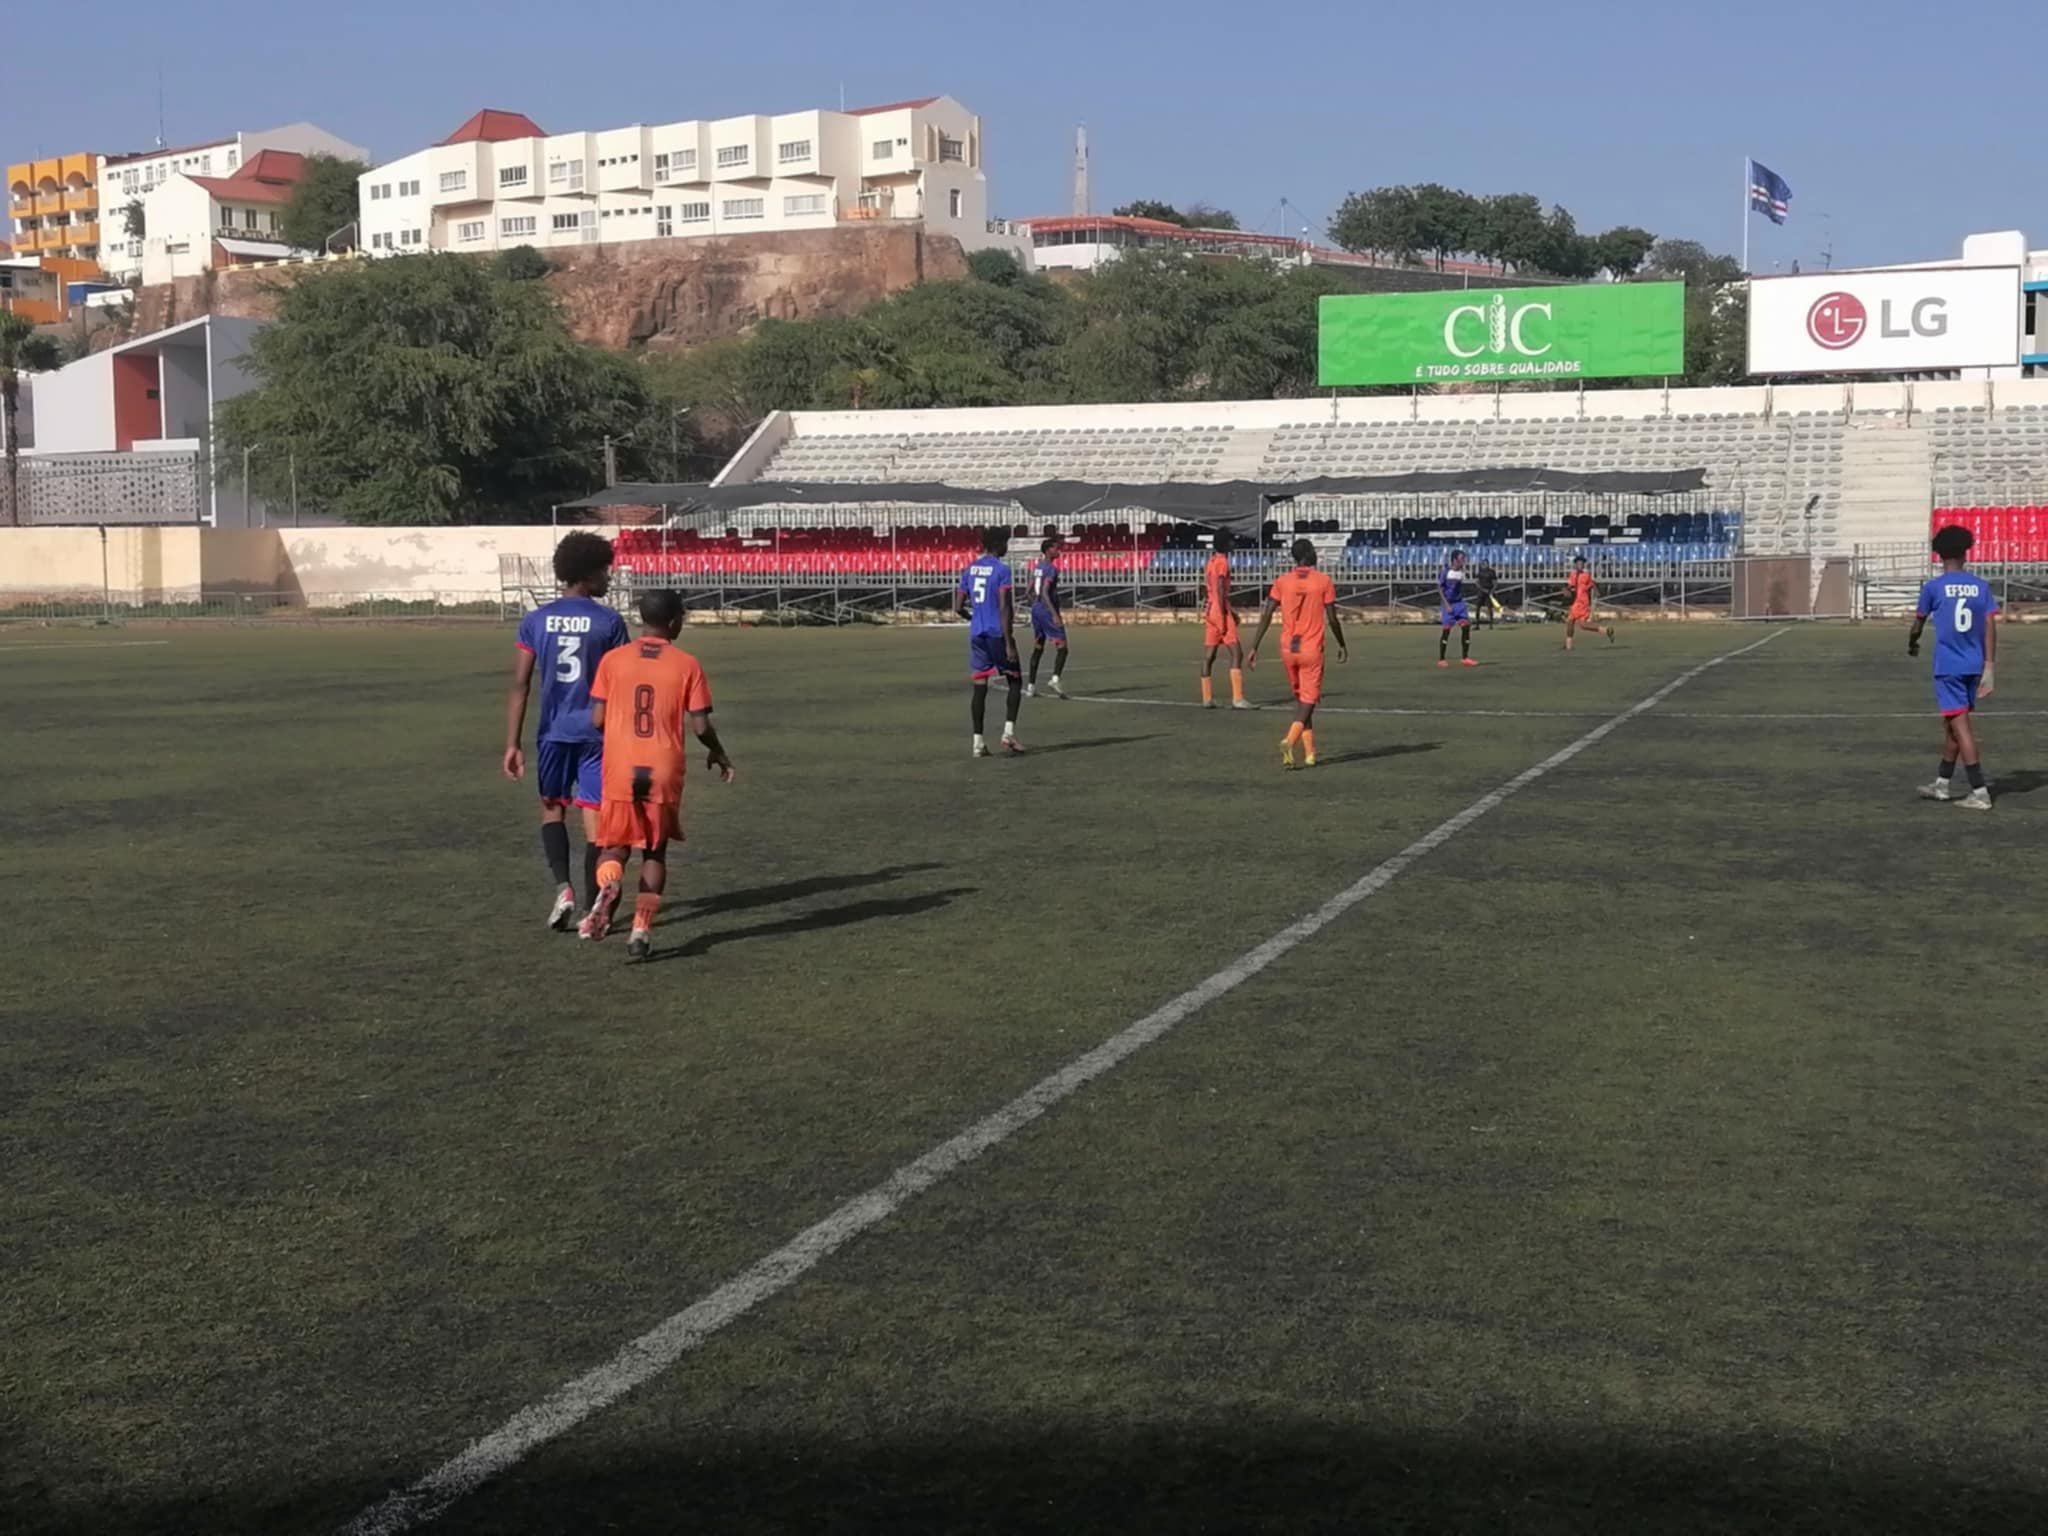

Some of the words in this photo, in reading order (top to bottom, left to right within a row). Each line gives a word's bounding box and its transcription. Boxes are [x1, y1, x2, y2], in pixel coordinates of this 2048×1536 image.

[1881, 297, 1948, 338] LG
[1427, 364, 1460, 378] TUDO
[1464, 363, 1505, 376] SOBRE
[1509, 361, 1582, 376] QUALIDADE
[973, 577, 987, 604] 5
[1944, 584, 1979, 598] EFSOD
[1295, 591, 1307, 621] 7
[1954, 598, 1973, 632] 6
[546, 615, 591, 633] EFSOD
[556, 635, 581, 683] 3
[634, 684, 655, 738] 8
